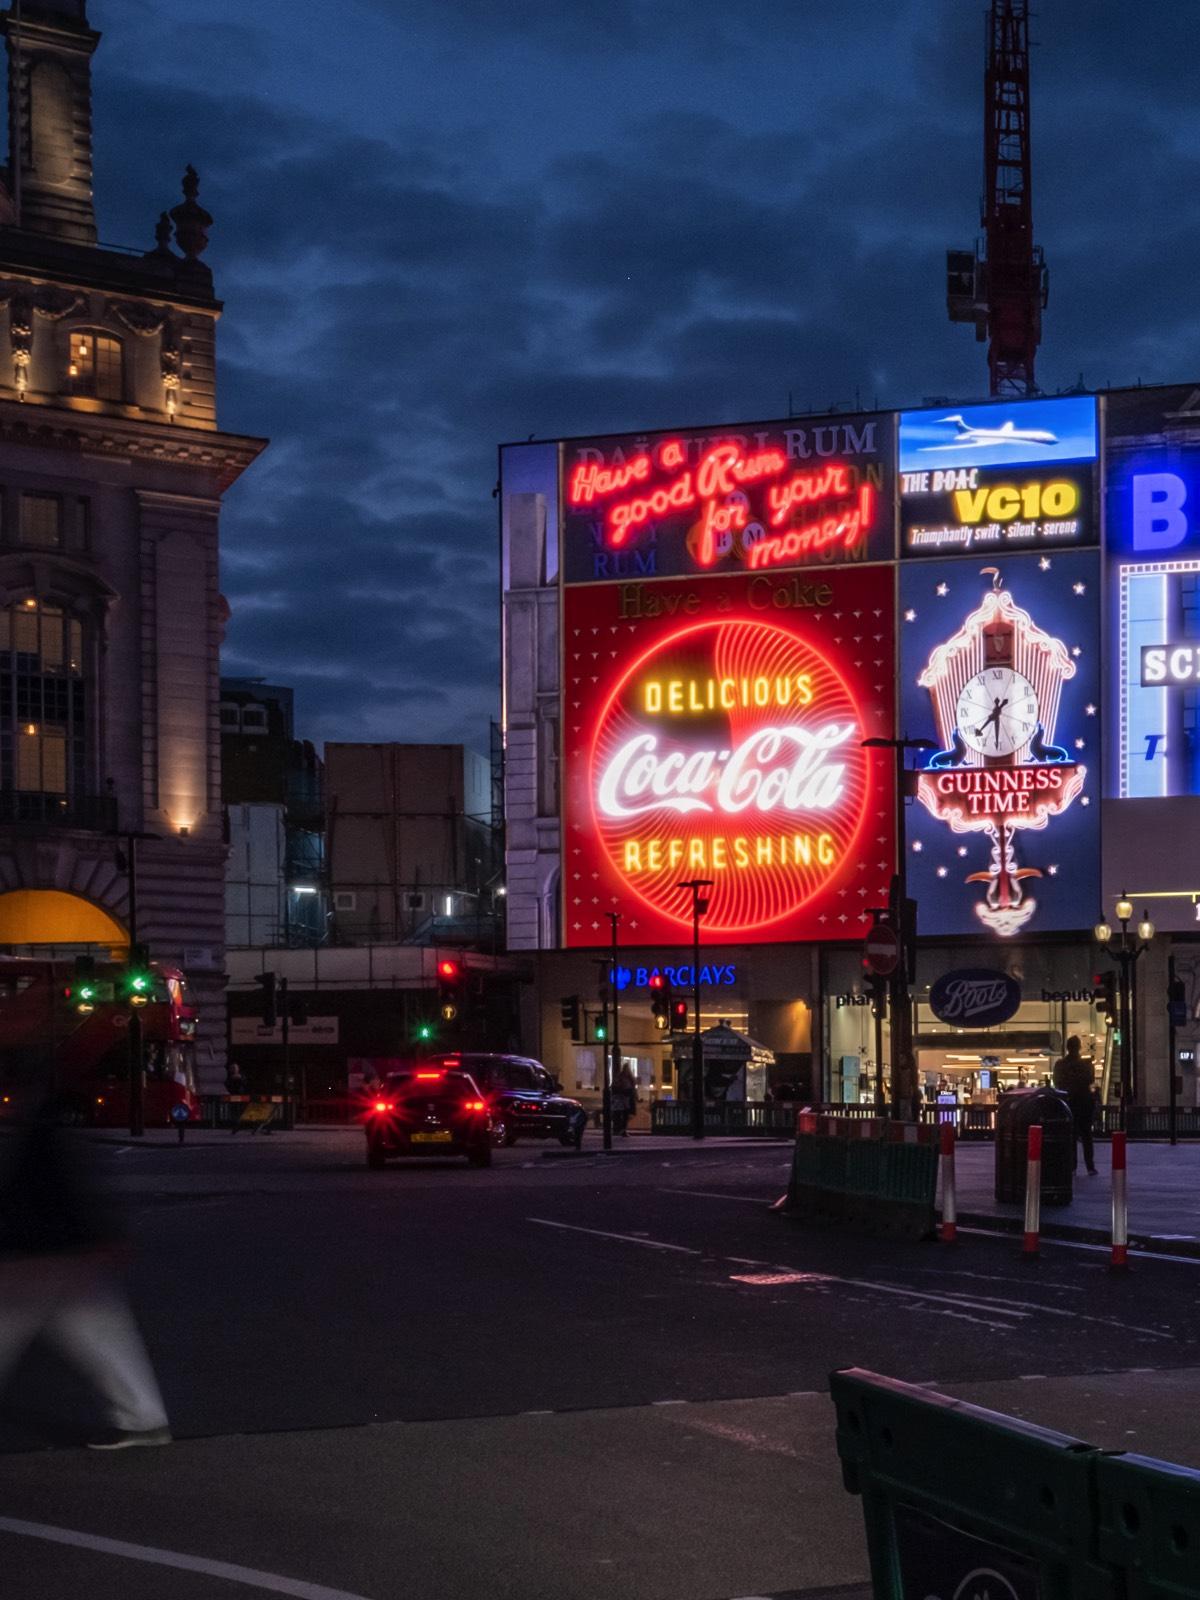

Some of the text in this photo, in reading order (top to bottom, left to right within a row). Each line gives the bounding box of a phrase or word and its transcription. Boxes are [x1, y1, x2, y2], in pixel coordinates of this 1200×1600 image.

[784, 422, 877, 460] RUM
[571, 441, 685, 502] Have a
[902, 472, 929, 492] THE
[609, 471, 695, 544] good
[697, 446, 784, 497] Rum
[955, 483, 1077, 522] VC10
[701, 501, 746, 564] for
[770, 466, 848, 526] your
[911, 520, 1077, 546] Triumphantly swift silent serene
[594, 550, 657, 577] RUM
[618, 582, 700, 619] Have
[747, 576, 834, 610] Coke
[645, 675, 812, 712] DELICIOUS
[599, 724, 856, 816] Coca-Cola
[937, 768, 1063, 794] GUINNESS
[968, 792, 1031, 815] TIME
[624, 834, 834, 871] REFRESHING
[938, 978, 1008, 1018] Boots
[1041, 988, 1095, 1005] beauty
